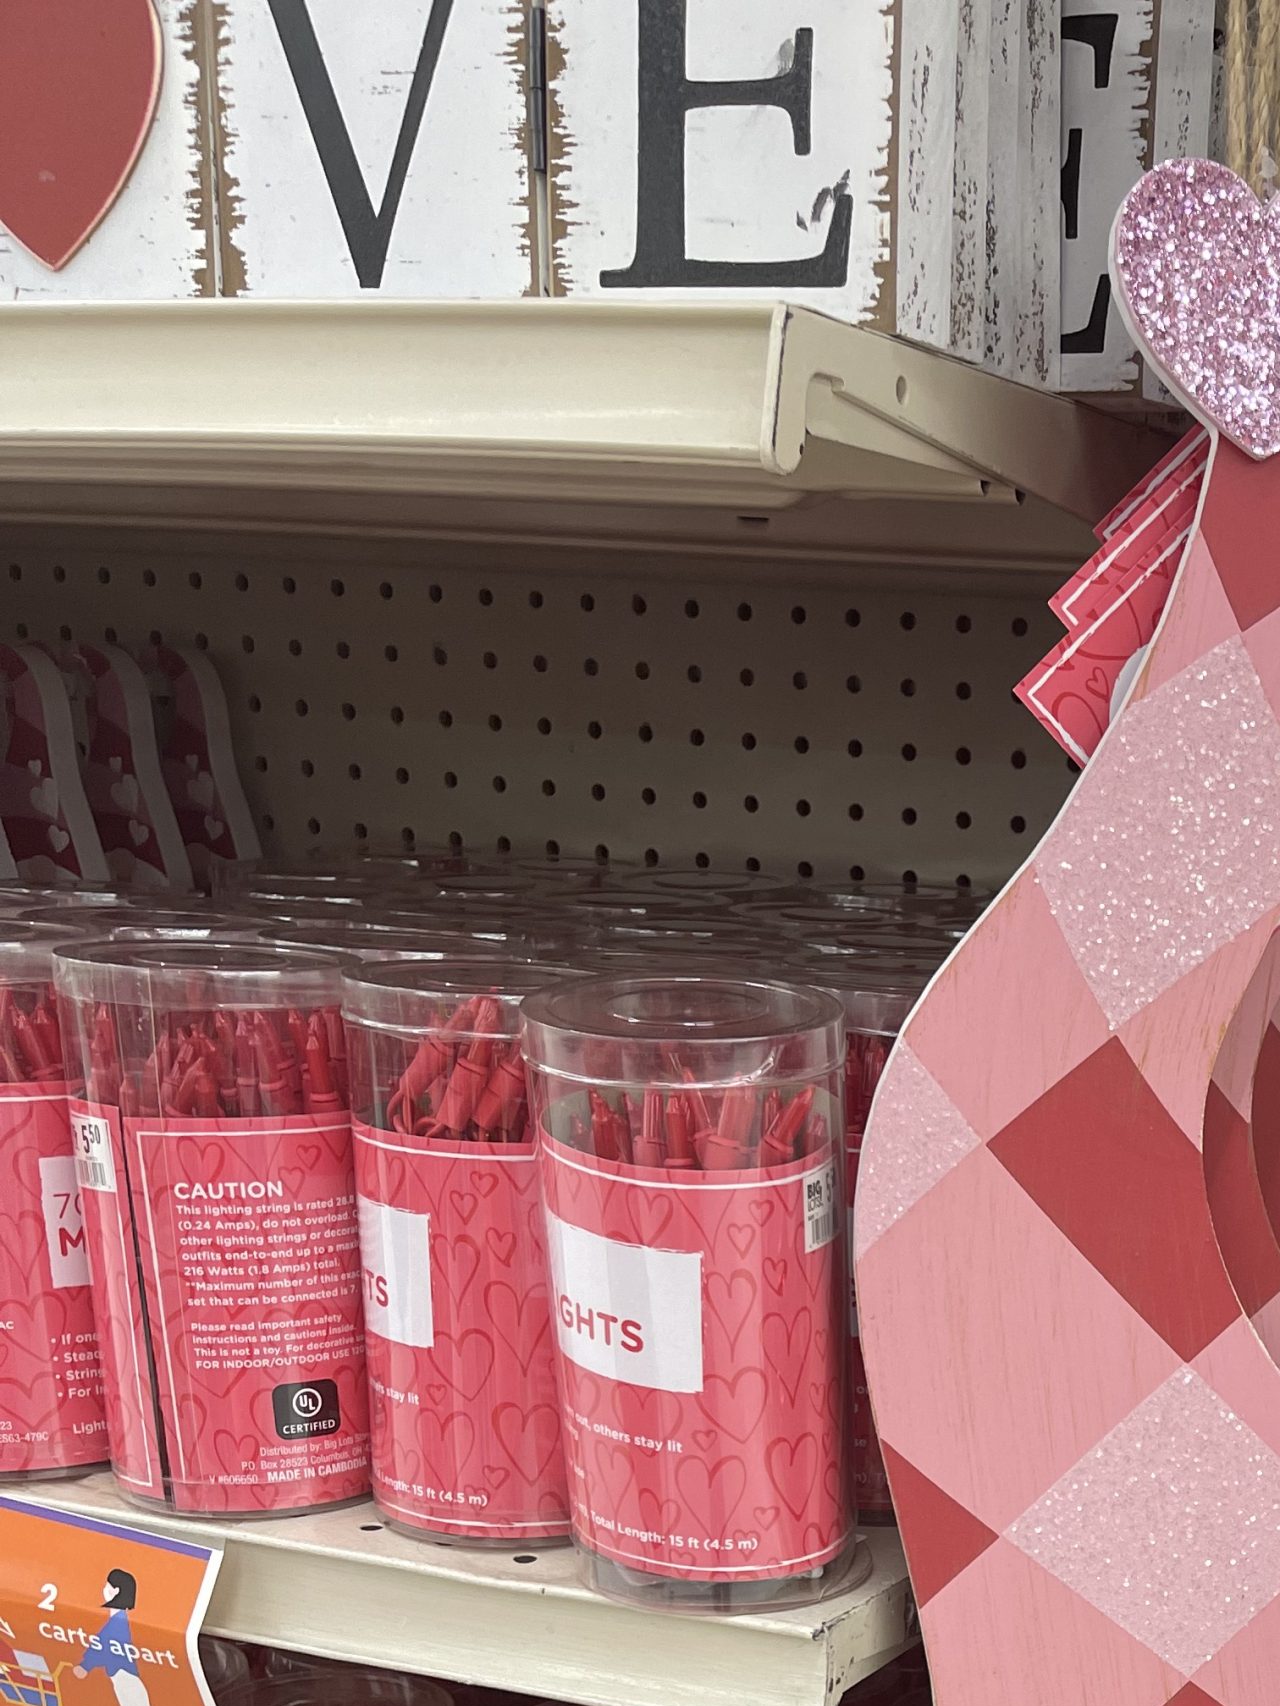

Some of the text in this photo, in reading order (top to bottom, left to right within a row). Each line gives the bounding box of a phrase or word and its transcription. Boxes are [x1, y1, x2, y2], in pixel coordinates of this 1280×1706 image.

[173, 1180, 284, 1200] CAUTION
[175, 1199, 334, 1217] This lighting string rated
[177, 1217, 302, 1233] (0.24 Amps), do not
[179, 1230, 322, 1248] other lighting strings or
[181, 1244, 326, 1262] outfits end-to-end up to
[183, 1258, 341, 1277] 216 Watts (1.8 Amps) total.
[257, 1272, 339, 1290] number of this
[187, 1287, 339, 1307] set that can be connected
[190, 1314, 343, 1332] Please read important safety
[192, 1328, 327, 1345] instructions and cautions
[194, 1337, 355, 1358] This not toy. For decorative
[195, 1350, 350, 1370] FOR INDOOR/OUTDOOR USE
[298, 1393, 316, 1412] UL
[282, 1419, 336, 1435] CERTIFIED
[323, 1438, 337, 1450] Big
[593, 1422, 683, 1454] others stay lit
[260, 1456, 309, 1470] Box 28523
[267, 1456, 368, 1483] MADE IN CAMBODIA
[617, 1522, 666, 1546] Length:
[668, 1534, 684, 1548] 15
[687, 1535, 700, 1549] ft
[703, 1537, 734, 1552] (4.5
[737, 1538, 758, 1551] m)
[37, 1583, 59, 1612] 2
[38, 1620, 180, 1669] carts apart
